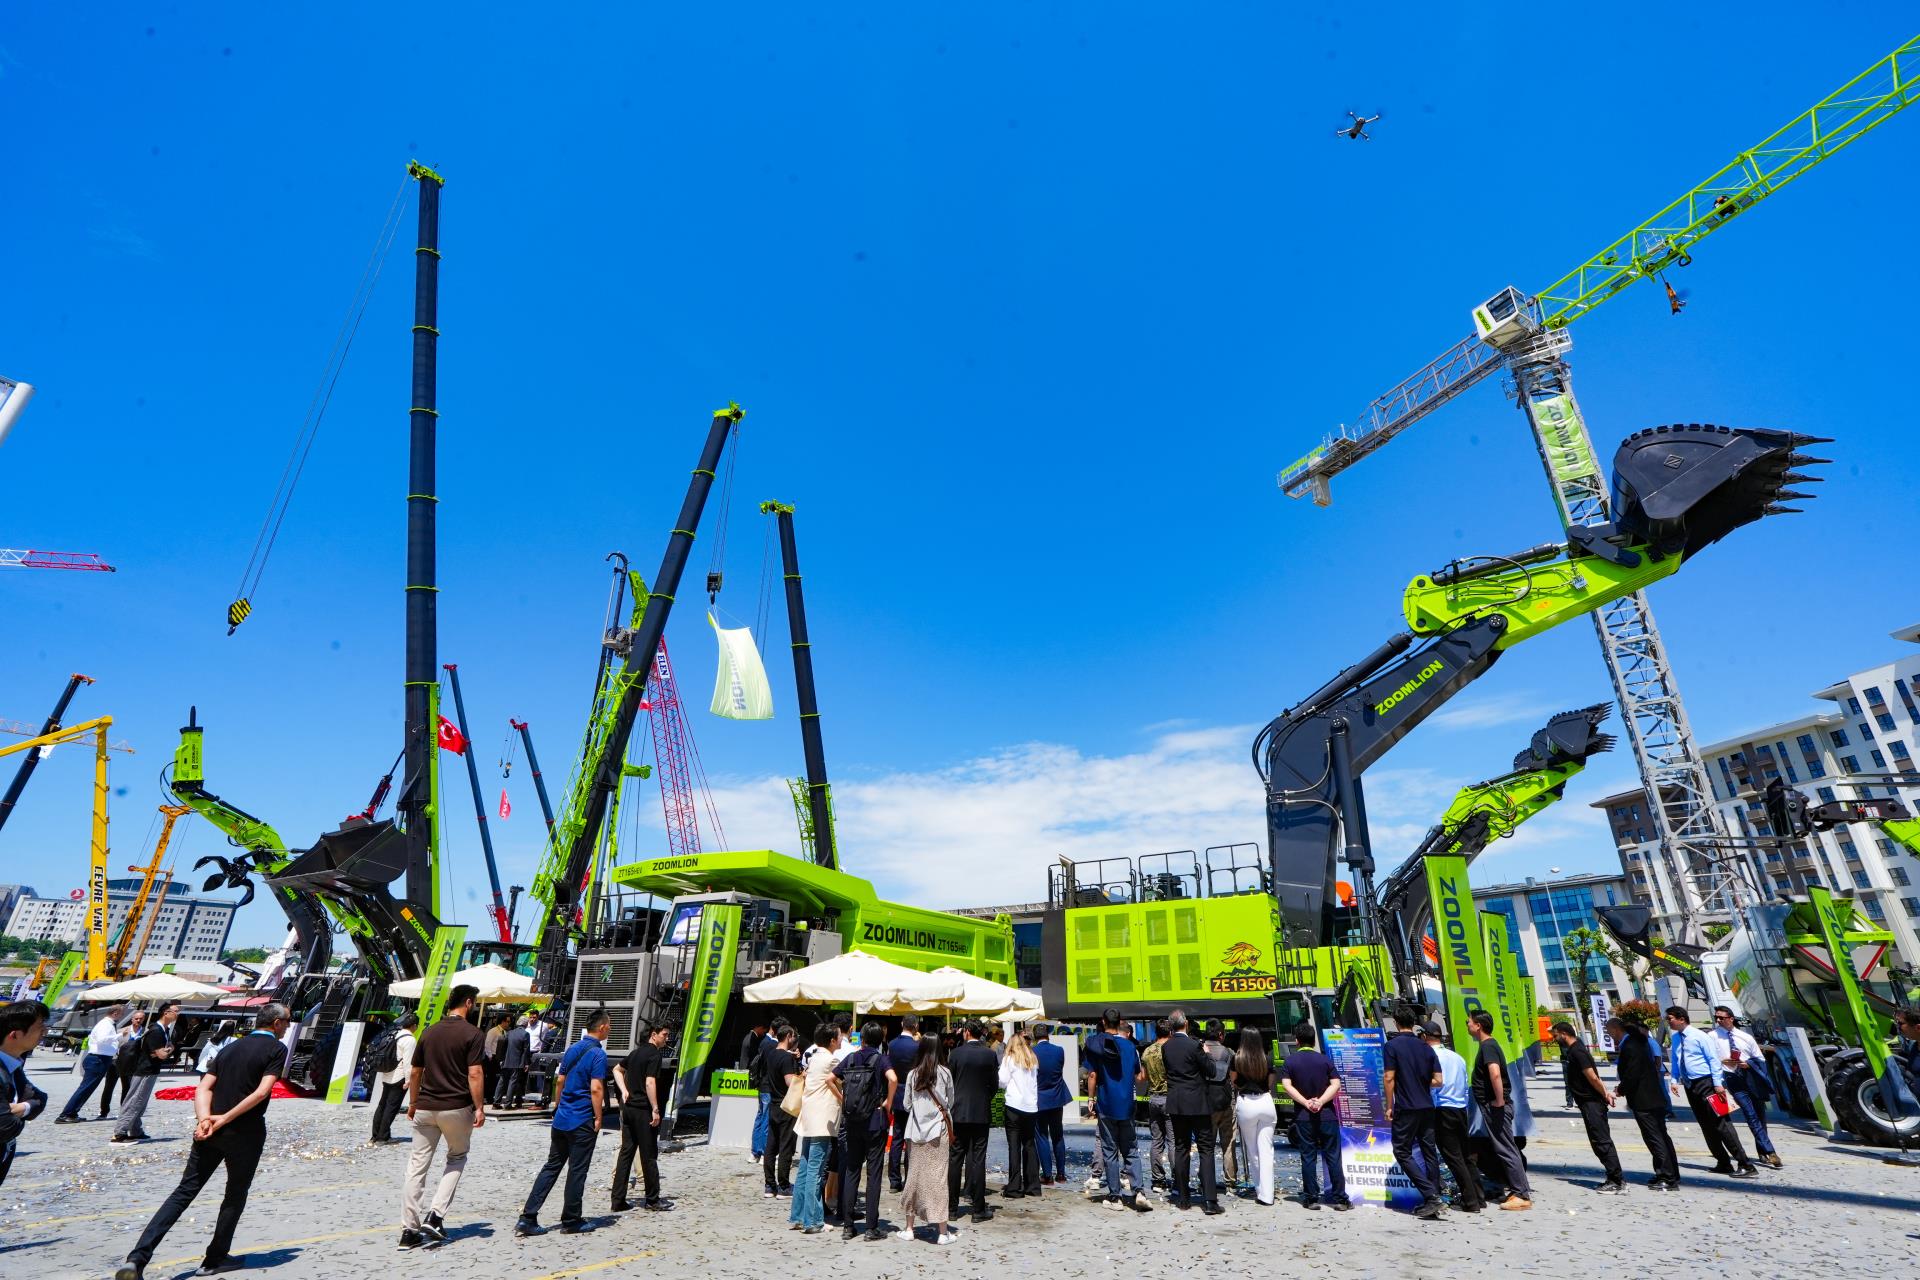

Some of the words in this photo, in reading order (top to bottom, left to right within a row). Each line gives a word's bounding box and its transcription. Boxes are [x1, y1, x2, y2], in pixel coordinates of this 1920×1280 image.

[657, 654, 669, 677] ELEN
[1374, 659, 1444, 716] ZOOMLION
[652, 858, 699, 871] ZOOMLION
[410, 916, 435, 950] ZOOMLIO
[863, 922, 936, 949] ZOOMLION
[1439, 876, 1483, 1017] ZOOMLIO
[696, 920, 727, 1043] ZOOMLION
[1212, 977, 1277, 992] ZE1350G
[1489, 927, 1514, 1043] ZOOMLION
[1523, 983, 1534, 1034] ZOOMLION
